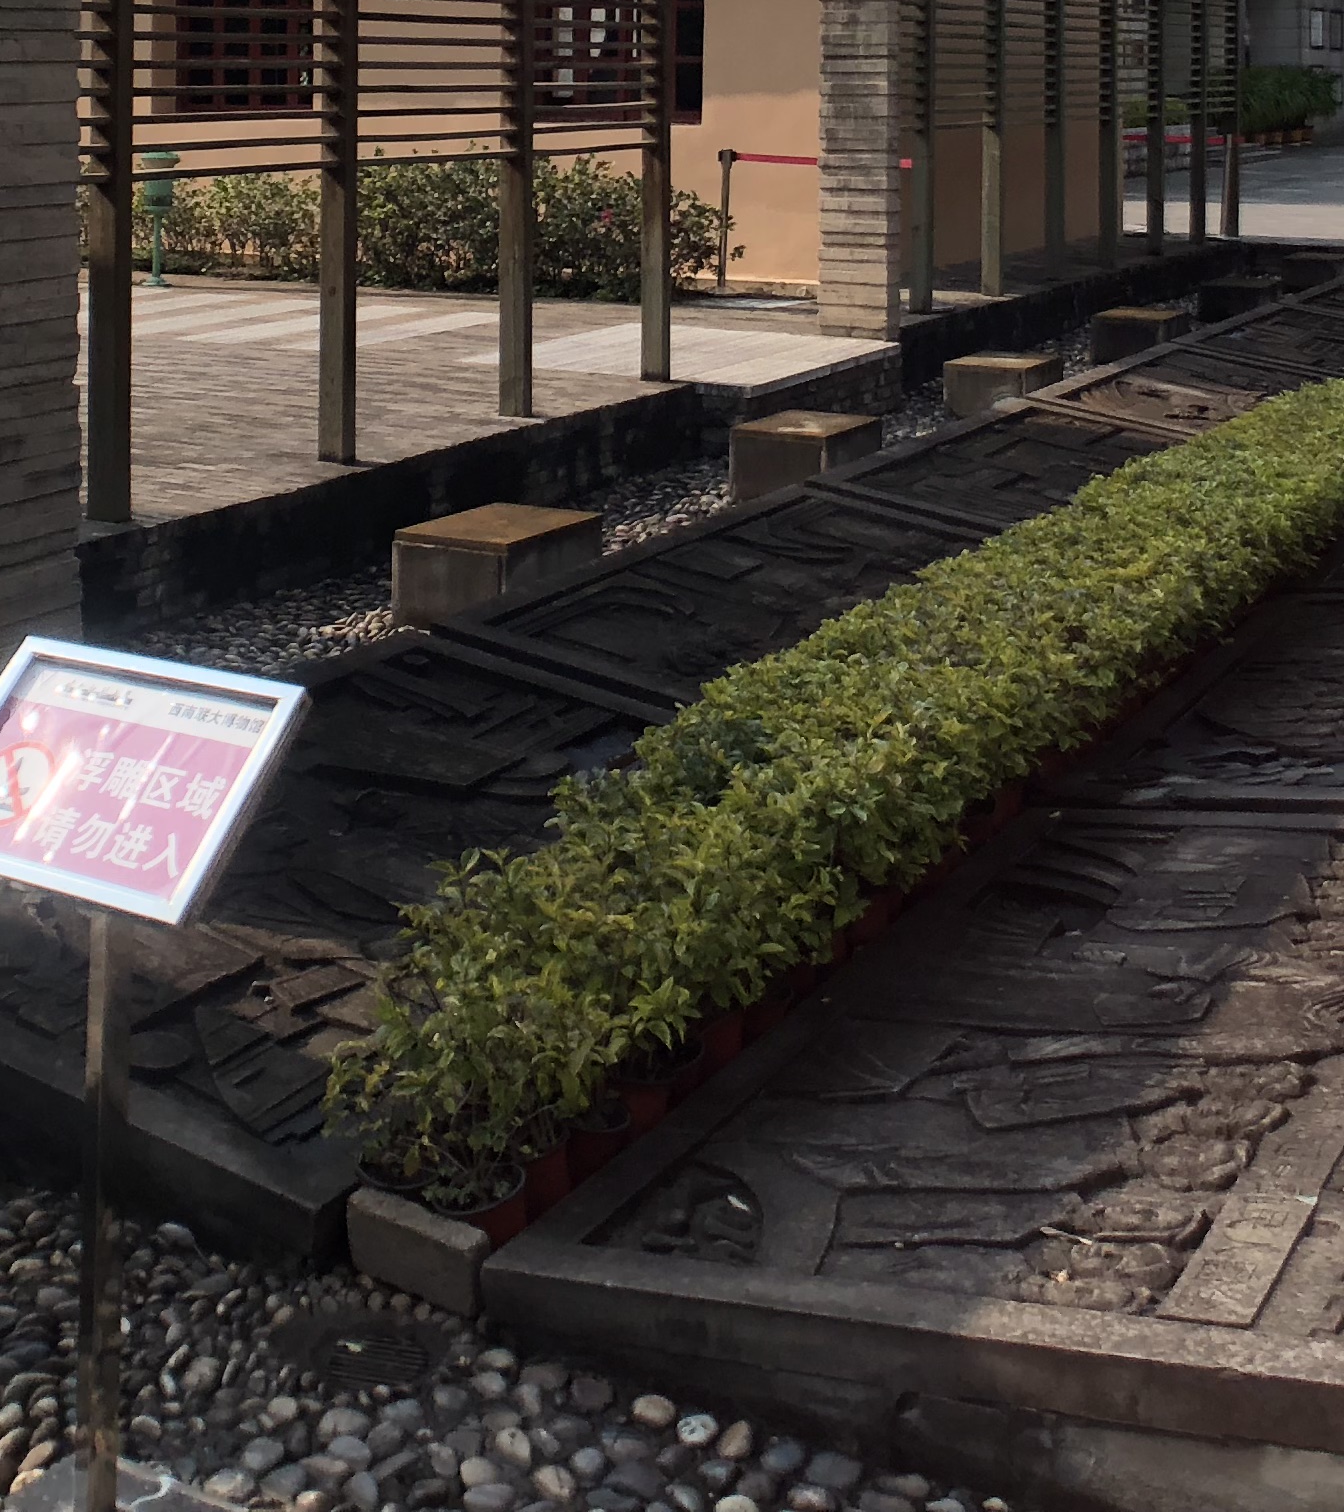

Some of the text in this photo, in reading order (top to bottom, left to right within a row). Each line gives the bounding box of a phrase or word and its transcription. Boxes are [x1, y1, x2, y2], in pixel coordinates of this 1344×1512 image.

[167, 701, 267, 735] 西南联大博物馆
[70, 748, 227, 820] 浮雕区域
[31, 806, 179, 879] 请勿进入
